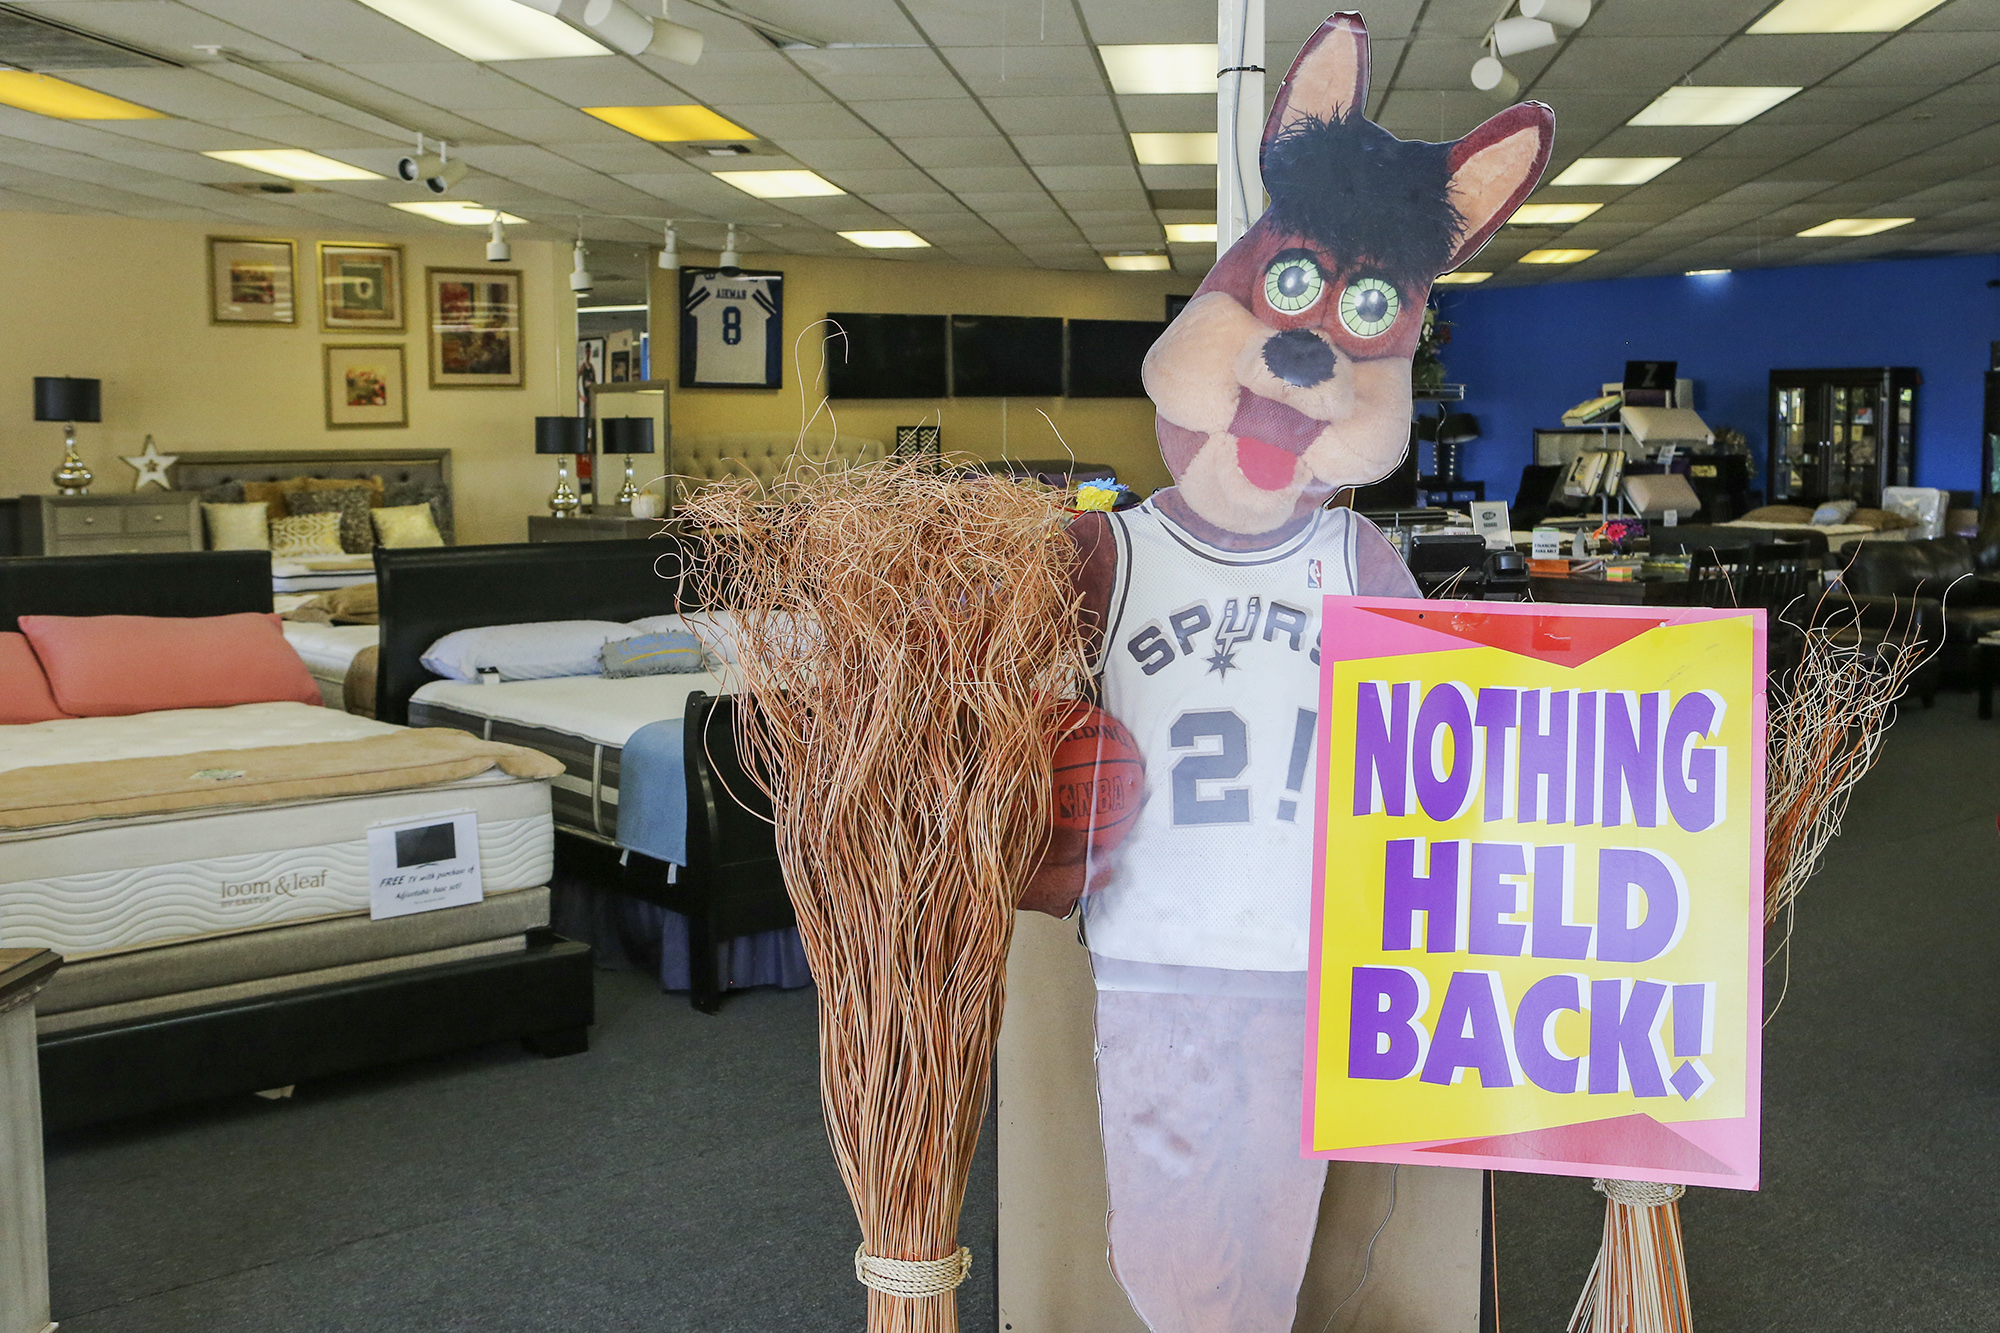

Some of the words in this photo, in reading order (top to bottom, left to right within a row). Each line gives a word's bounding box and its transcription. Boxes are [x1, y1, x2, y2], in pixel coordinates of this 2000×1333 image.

[716, 288, 747, 300] AIKMAN
[722, 306, 741, 345] 8
[1127, 596, 1321, 682] SPUR
[1353, 680, 1727, 833] NOTHING
[1076, 775, 1125, 817] NBA
[221, 881, 271, 898] loom
[293, 869, 328, 890] leaf
[379, 875, 406, 887] FREE
[419, 873, 435, 881] with
[436, 867, 466, 880] purchase
[467, 865, 475, 874] of
[395, 888, 430, 900] Adjustable
[433, 885, 447, 893] base
[1382, 837, 1689, 963] HELD
[1348, 965, 1716, 1101] BACK!
